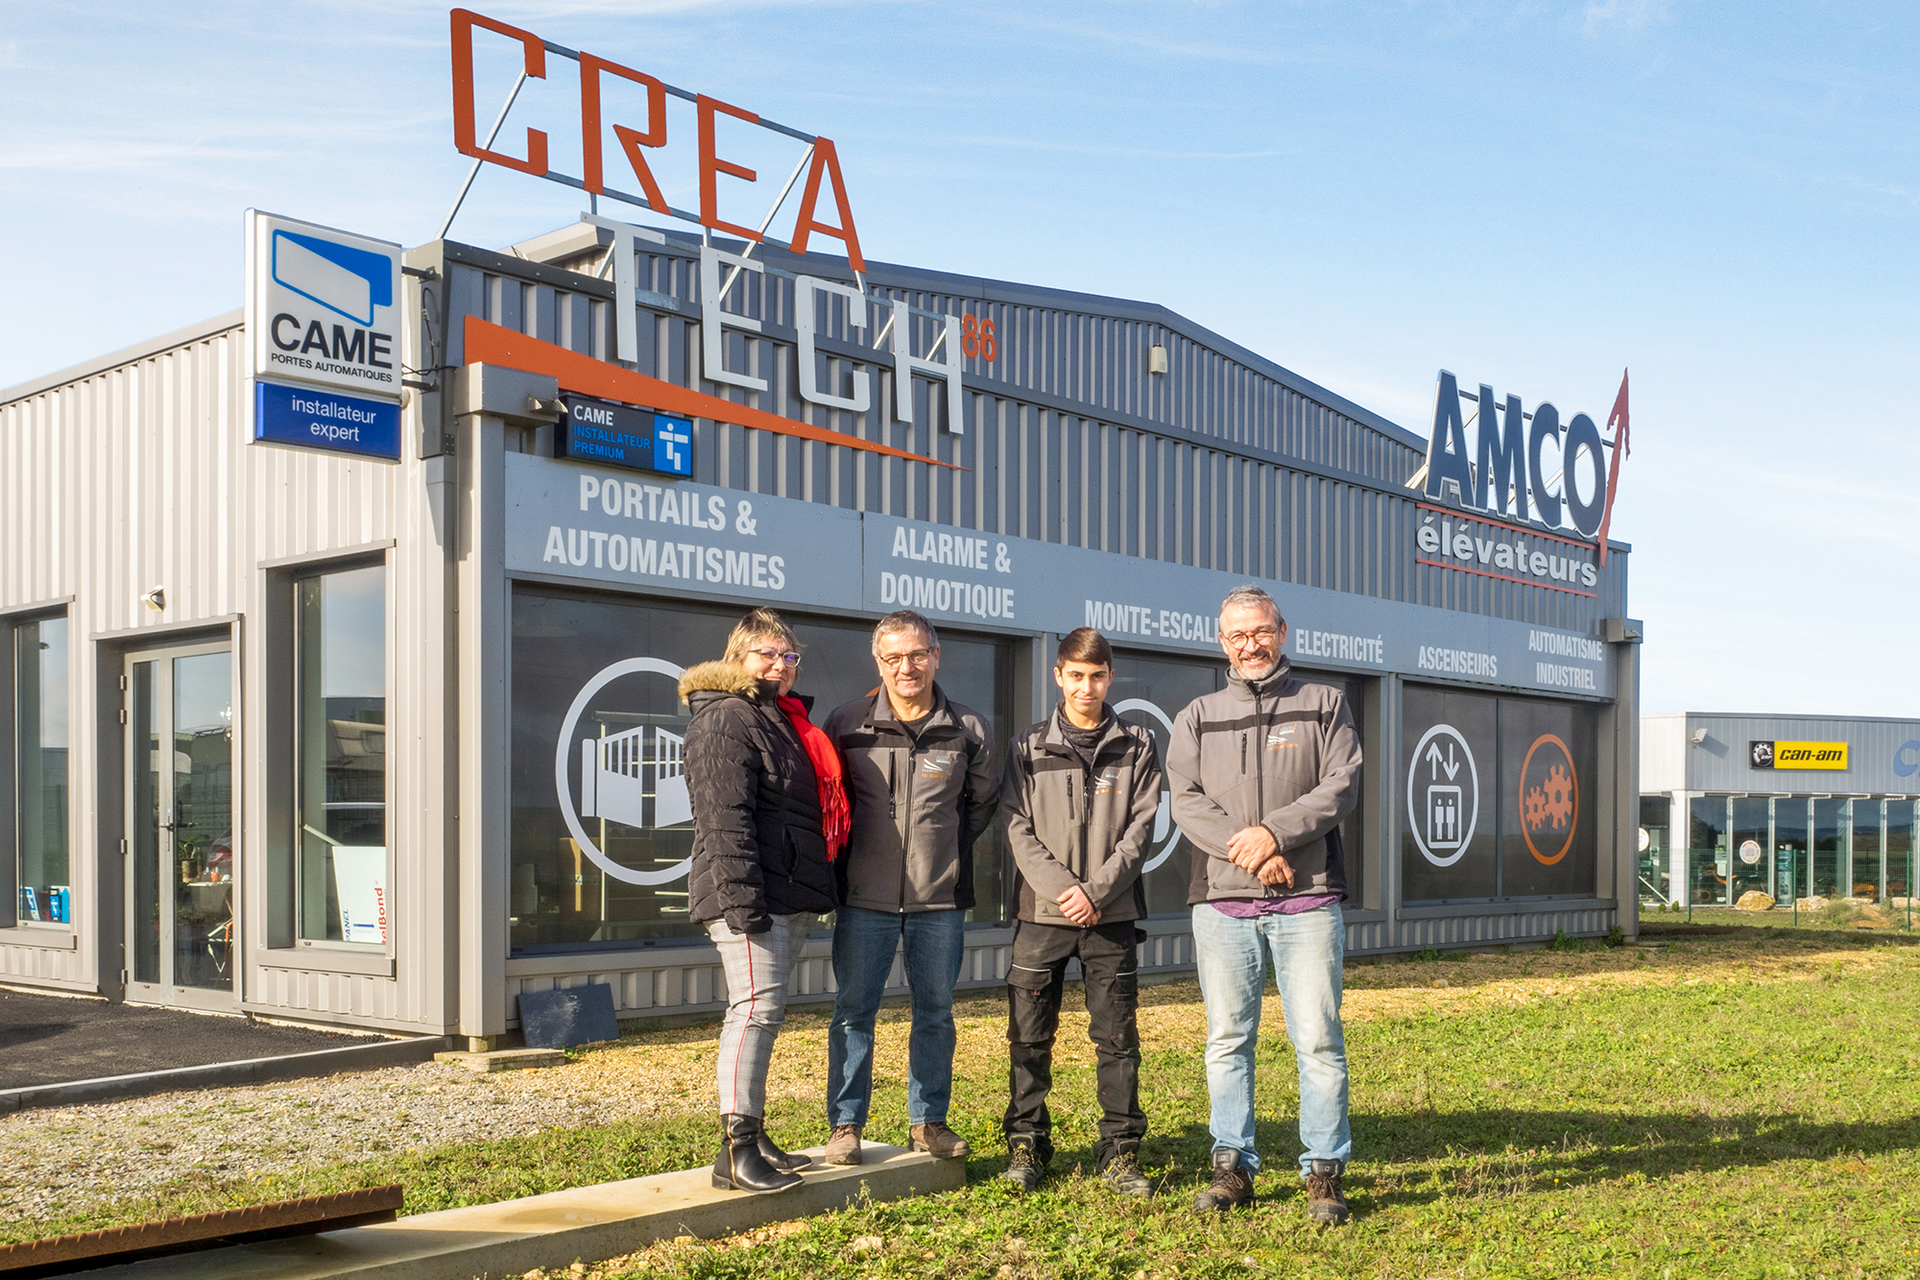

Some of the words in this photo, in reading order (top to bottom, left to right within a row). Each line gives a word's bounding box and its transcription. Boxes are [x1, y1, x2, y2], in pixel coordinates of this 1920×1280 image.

[451, 8, 866, 273] CREA
[581, 212, 964, 434] TECH
[963, 313, 997, 363] 86
[271, 313, 392, 370] CAME
[271, 353, 312, 369] PORTES
[315, 361, 392, 383] AUTOMATIQUES
[292, 395, 376, 424] installateur
[573, 404, 614, 426] CAME
[310, 422, 360, 441] expert
[574, 425, 651, 449] INSTALLATEUR
[574, 441, 625, 460] PREMIUM
[1424, 368, 1607, 539] AMCO
[580, 474, 726, 531] PORTAILS
[735, 500, 757, 536] &
[543, 526, 786, 590] AUTOMATISMES
[892, 526, 988, 570] ALARME
[995, 542, 1011, 573] &
[1417, 516, 1597, 587] élévateurs
[881, 572, 1014, 619] DOMOTIQUE
[1085, 600, 1219, 643] MONTE-ESCALI
[1296, 628, 1383, 664] ELECTRICITÉ
[1418, 645, 1498, 678] ASCENSEURS
[1528, 630, 1602, 662] AUTOMATISME
[1536, 662, 1596, 690] INDUSTRIEL
[1779, 749, 1843, 761] can-am
